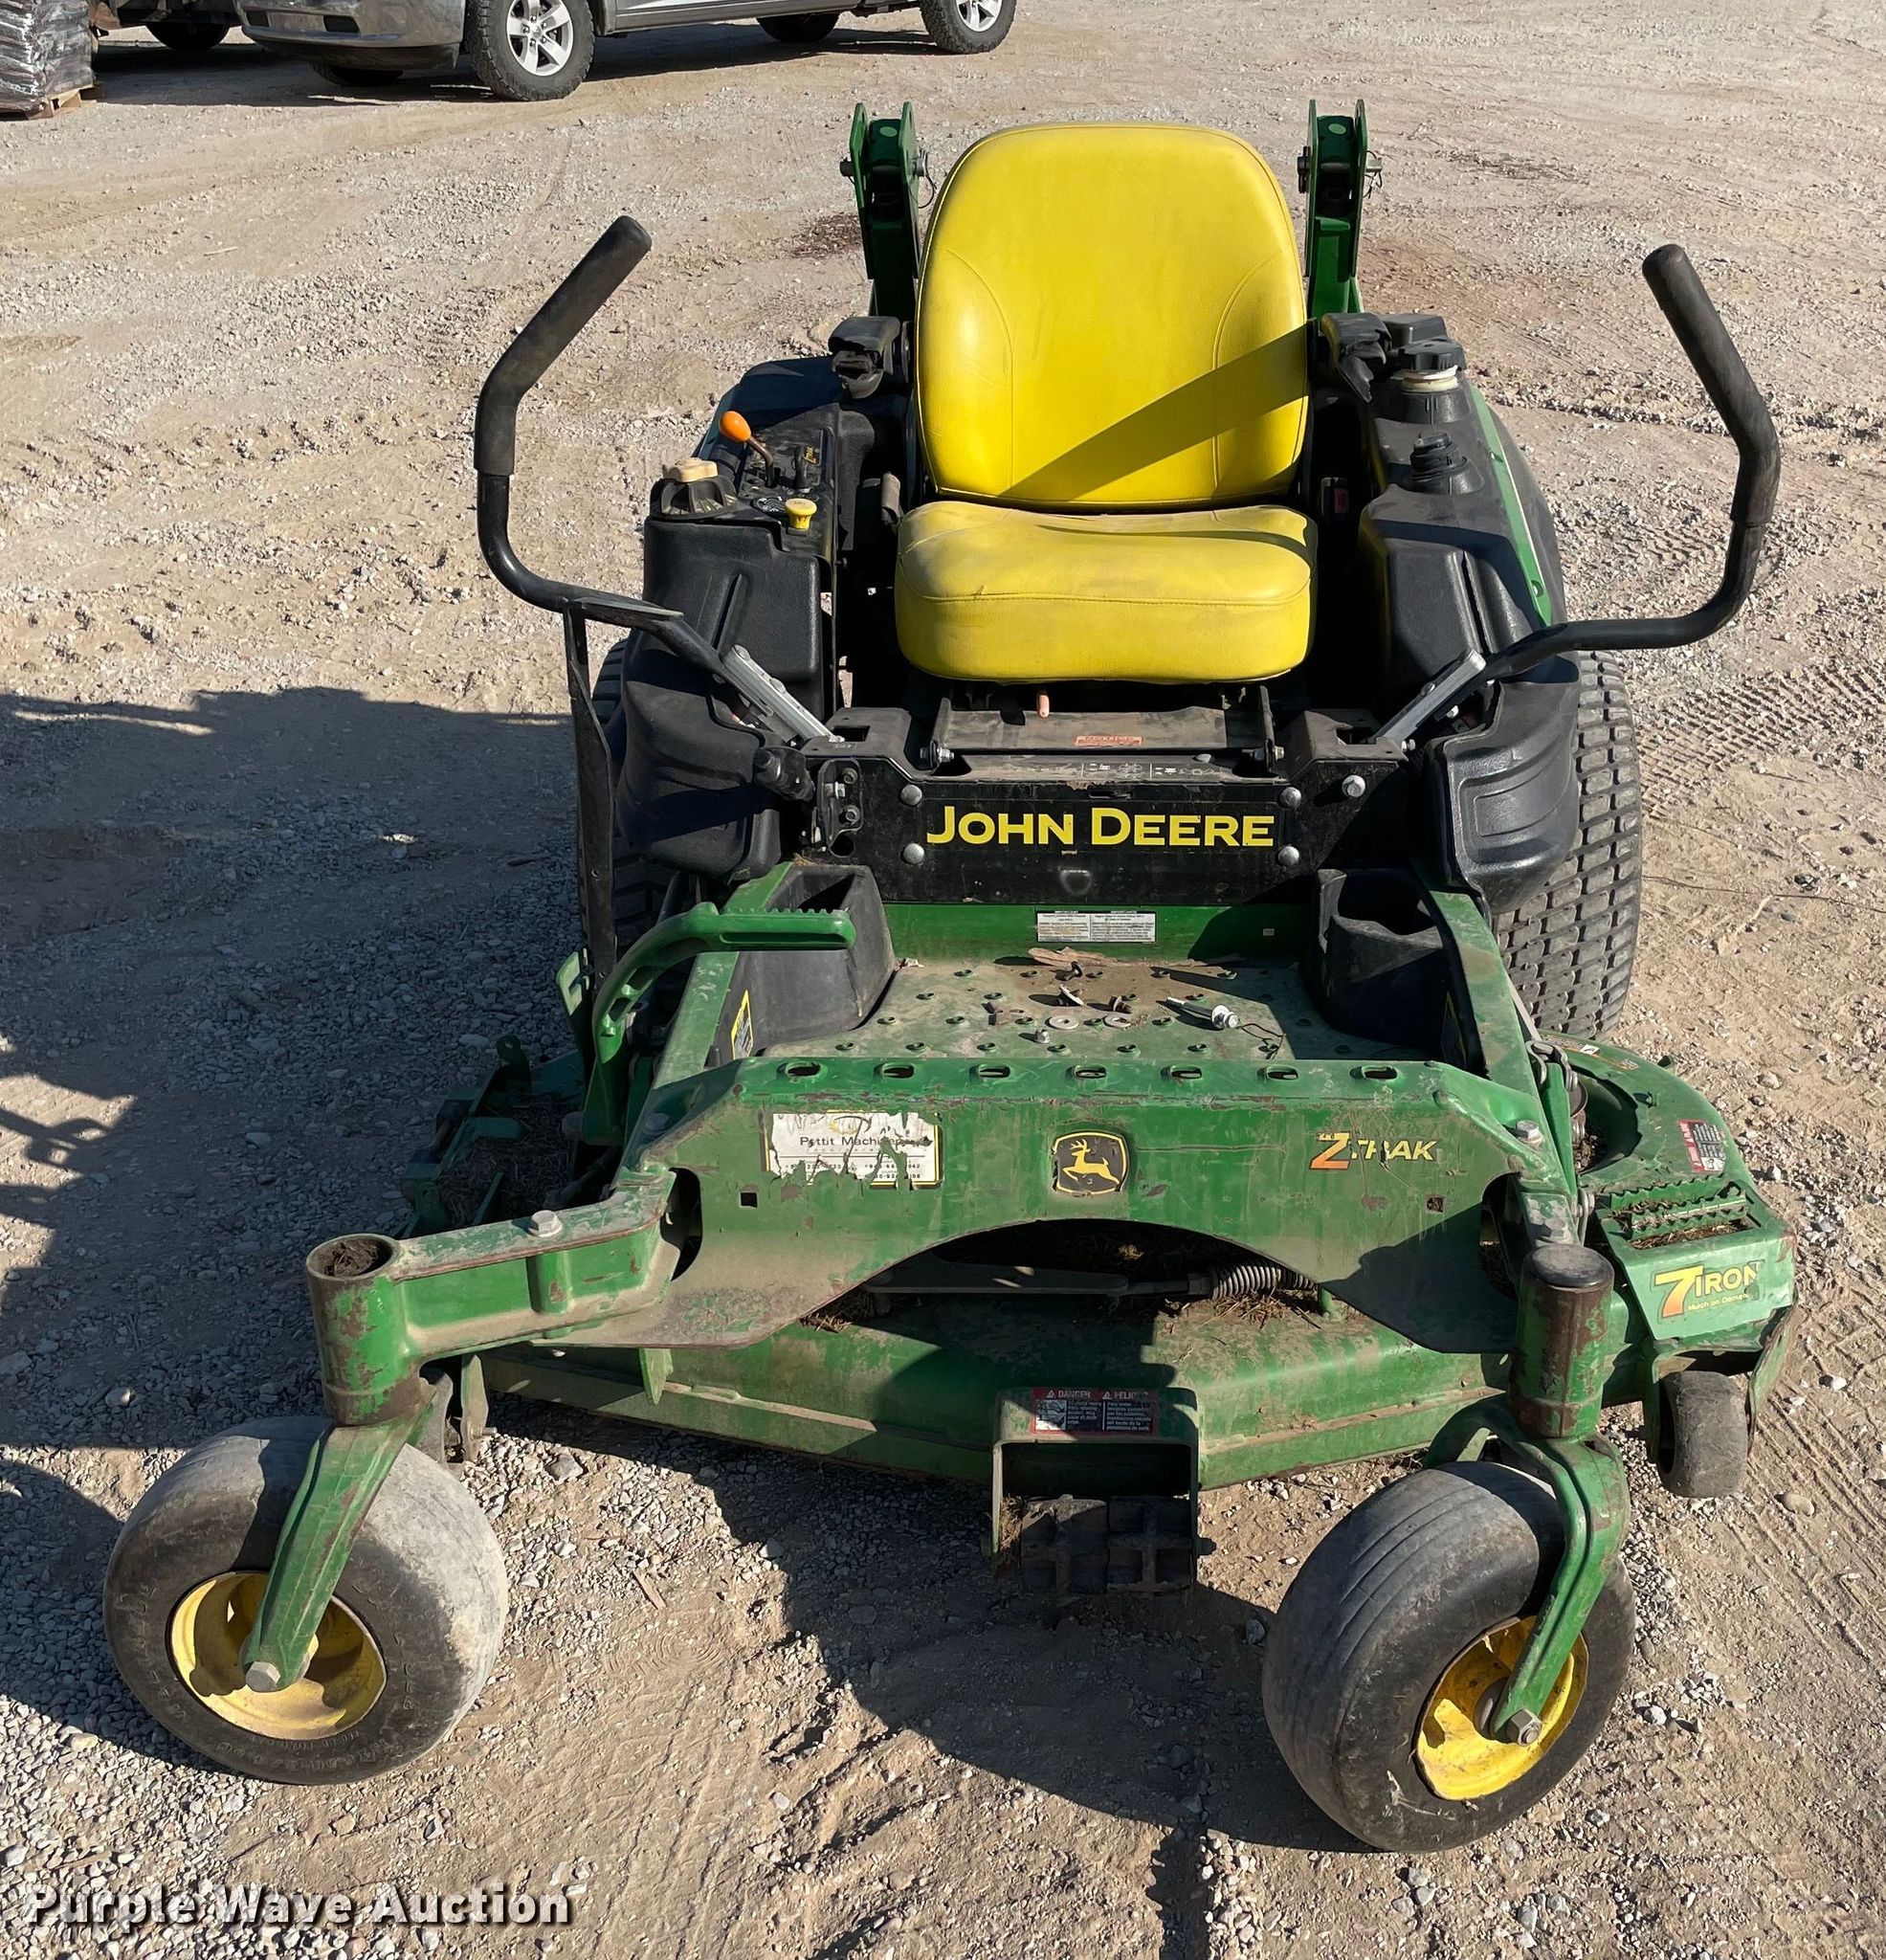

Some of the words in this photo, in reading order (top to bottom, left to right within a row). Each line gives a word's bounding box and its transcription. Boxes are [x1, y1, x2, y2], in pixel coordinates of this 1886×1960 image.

[926, 805, 1074, 845] JOHN
[1091, 807, 1276, 847] DEERE
[1721, 1293, 1750, 1303] Deman
